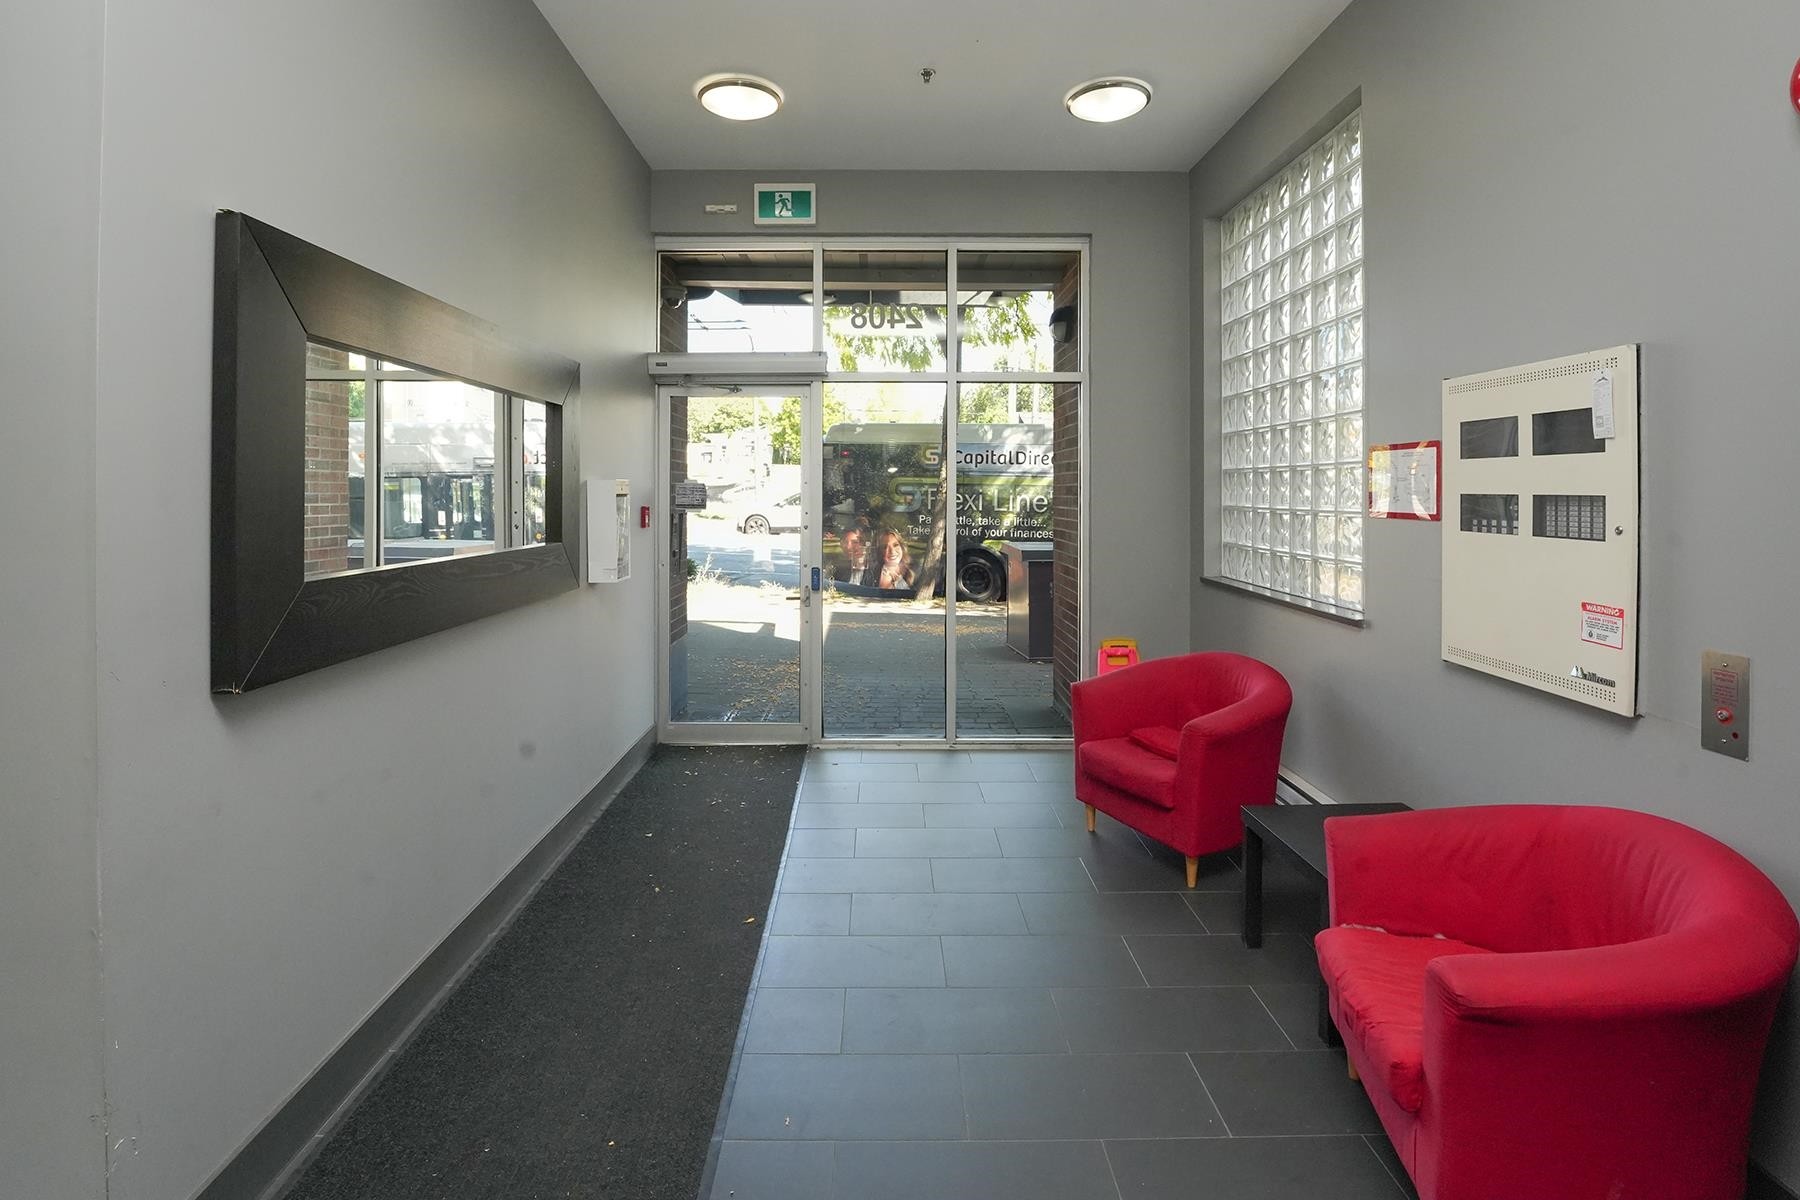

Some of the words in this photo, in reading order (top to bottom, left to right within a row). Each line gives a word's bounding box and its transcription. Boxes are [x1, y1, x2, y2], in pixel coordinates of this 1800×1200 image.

[978, 516, 1001, 527] take
[907, 525, 931, 536] Take
[972, 527, 982, 537] of
[985, 529, 1008, 540] your
[1009, 528, 1054, 540] finances
[1585, 603, 1620, 616] WARNING
